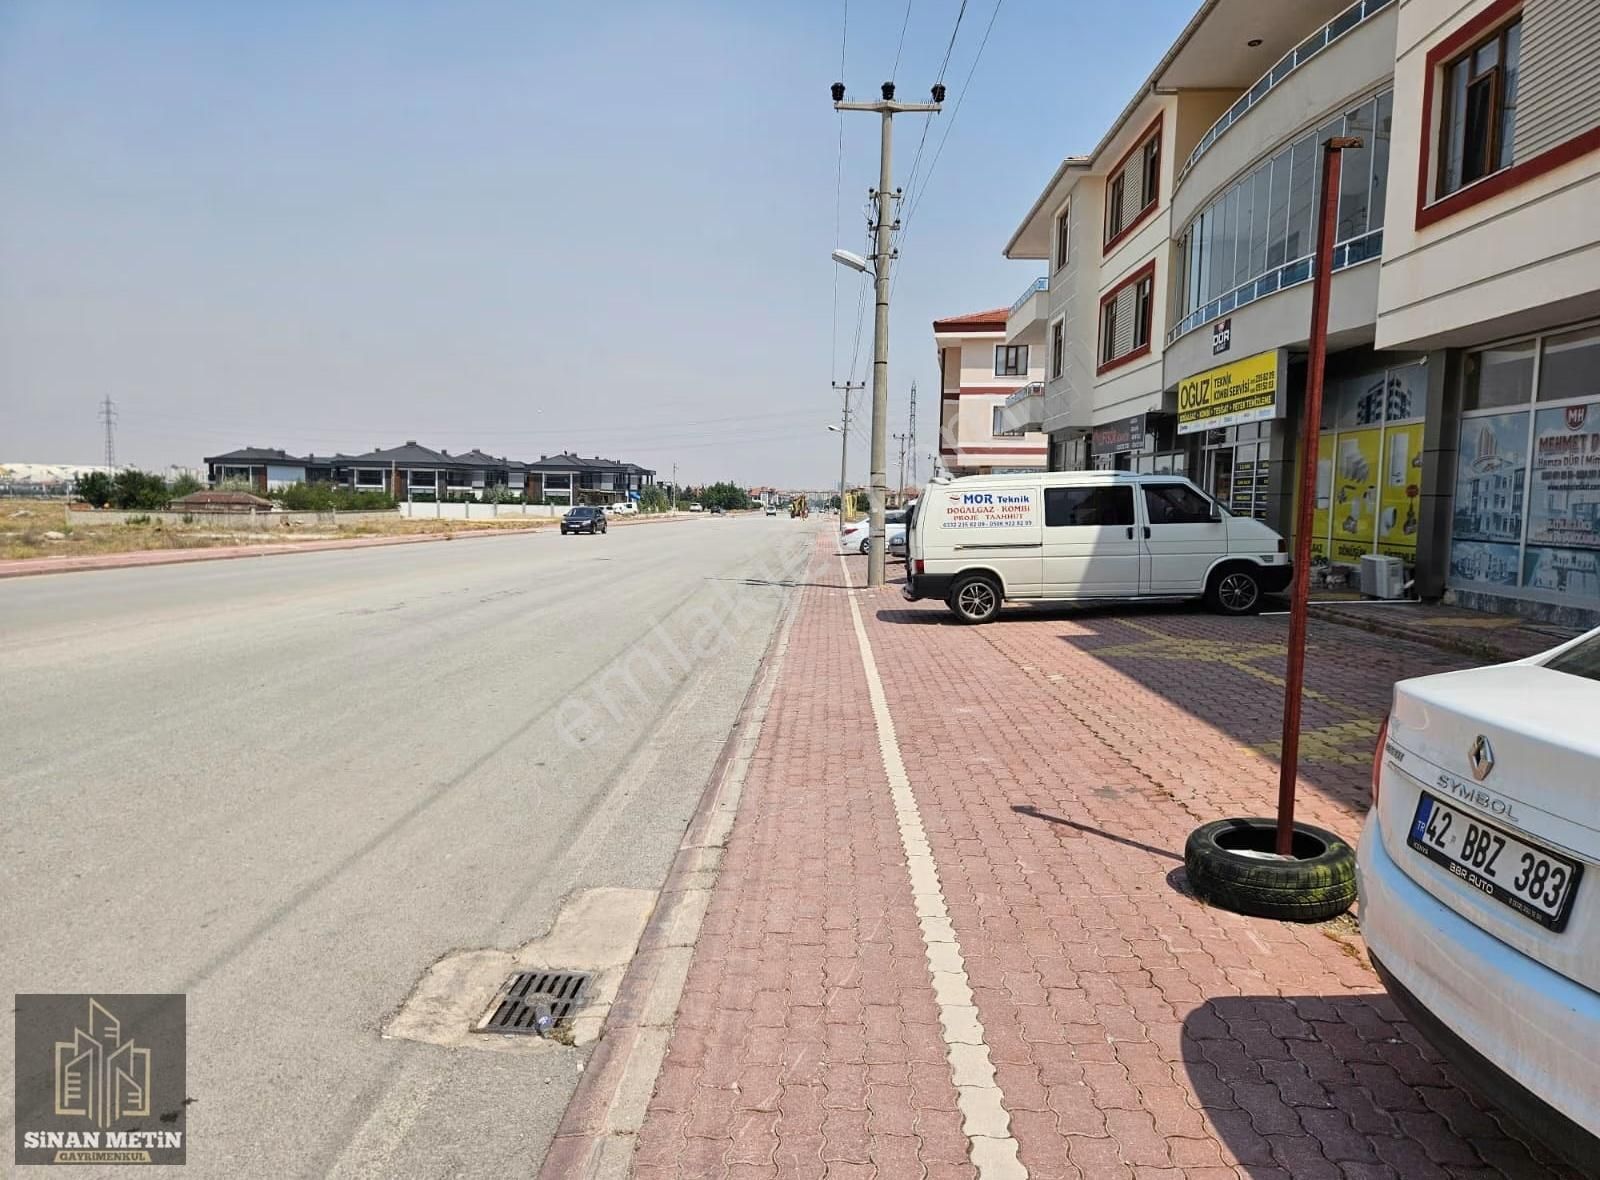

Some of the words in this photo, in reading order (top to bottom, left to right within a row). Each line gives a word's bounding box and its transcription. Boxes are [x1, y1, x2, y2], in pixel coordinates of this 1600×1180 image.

[1568, 408, 1585, 423] MH
[1538, 433, 1588, 452] MEHMET
[963, 493, 993, 505] MOR
[996, 494, 1030, 504] Teknik
[947, 505, 995, 515] DOĞALGAZ
[1436, 773, 1519, 822] SYMBOL
[1417, 820, 1425, 833] TR
[1425, 806, 1453, 849] 42
[1460, 823, 1507, 878] BBZ
[1513, 851, 1567, 909] 383
[1468, 874, 1494, 895] AUTO
